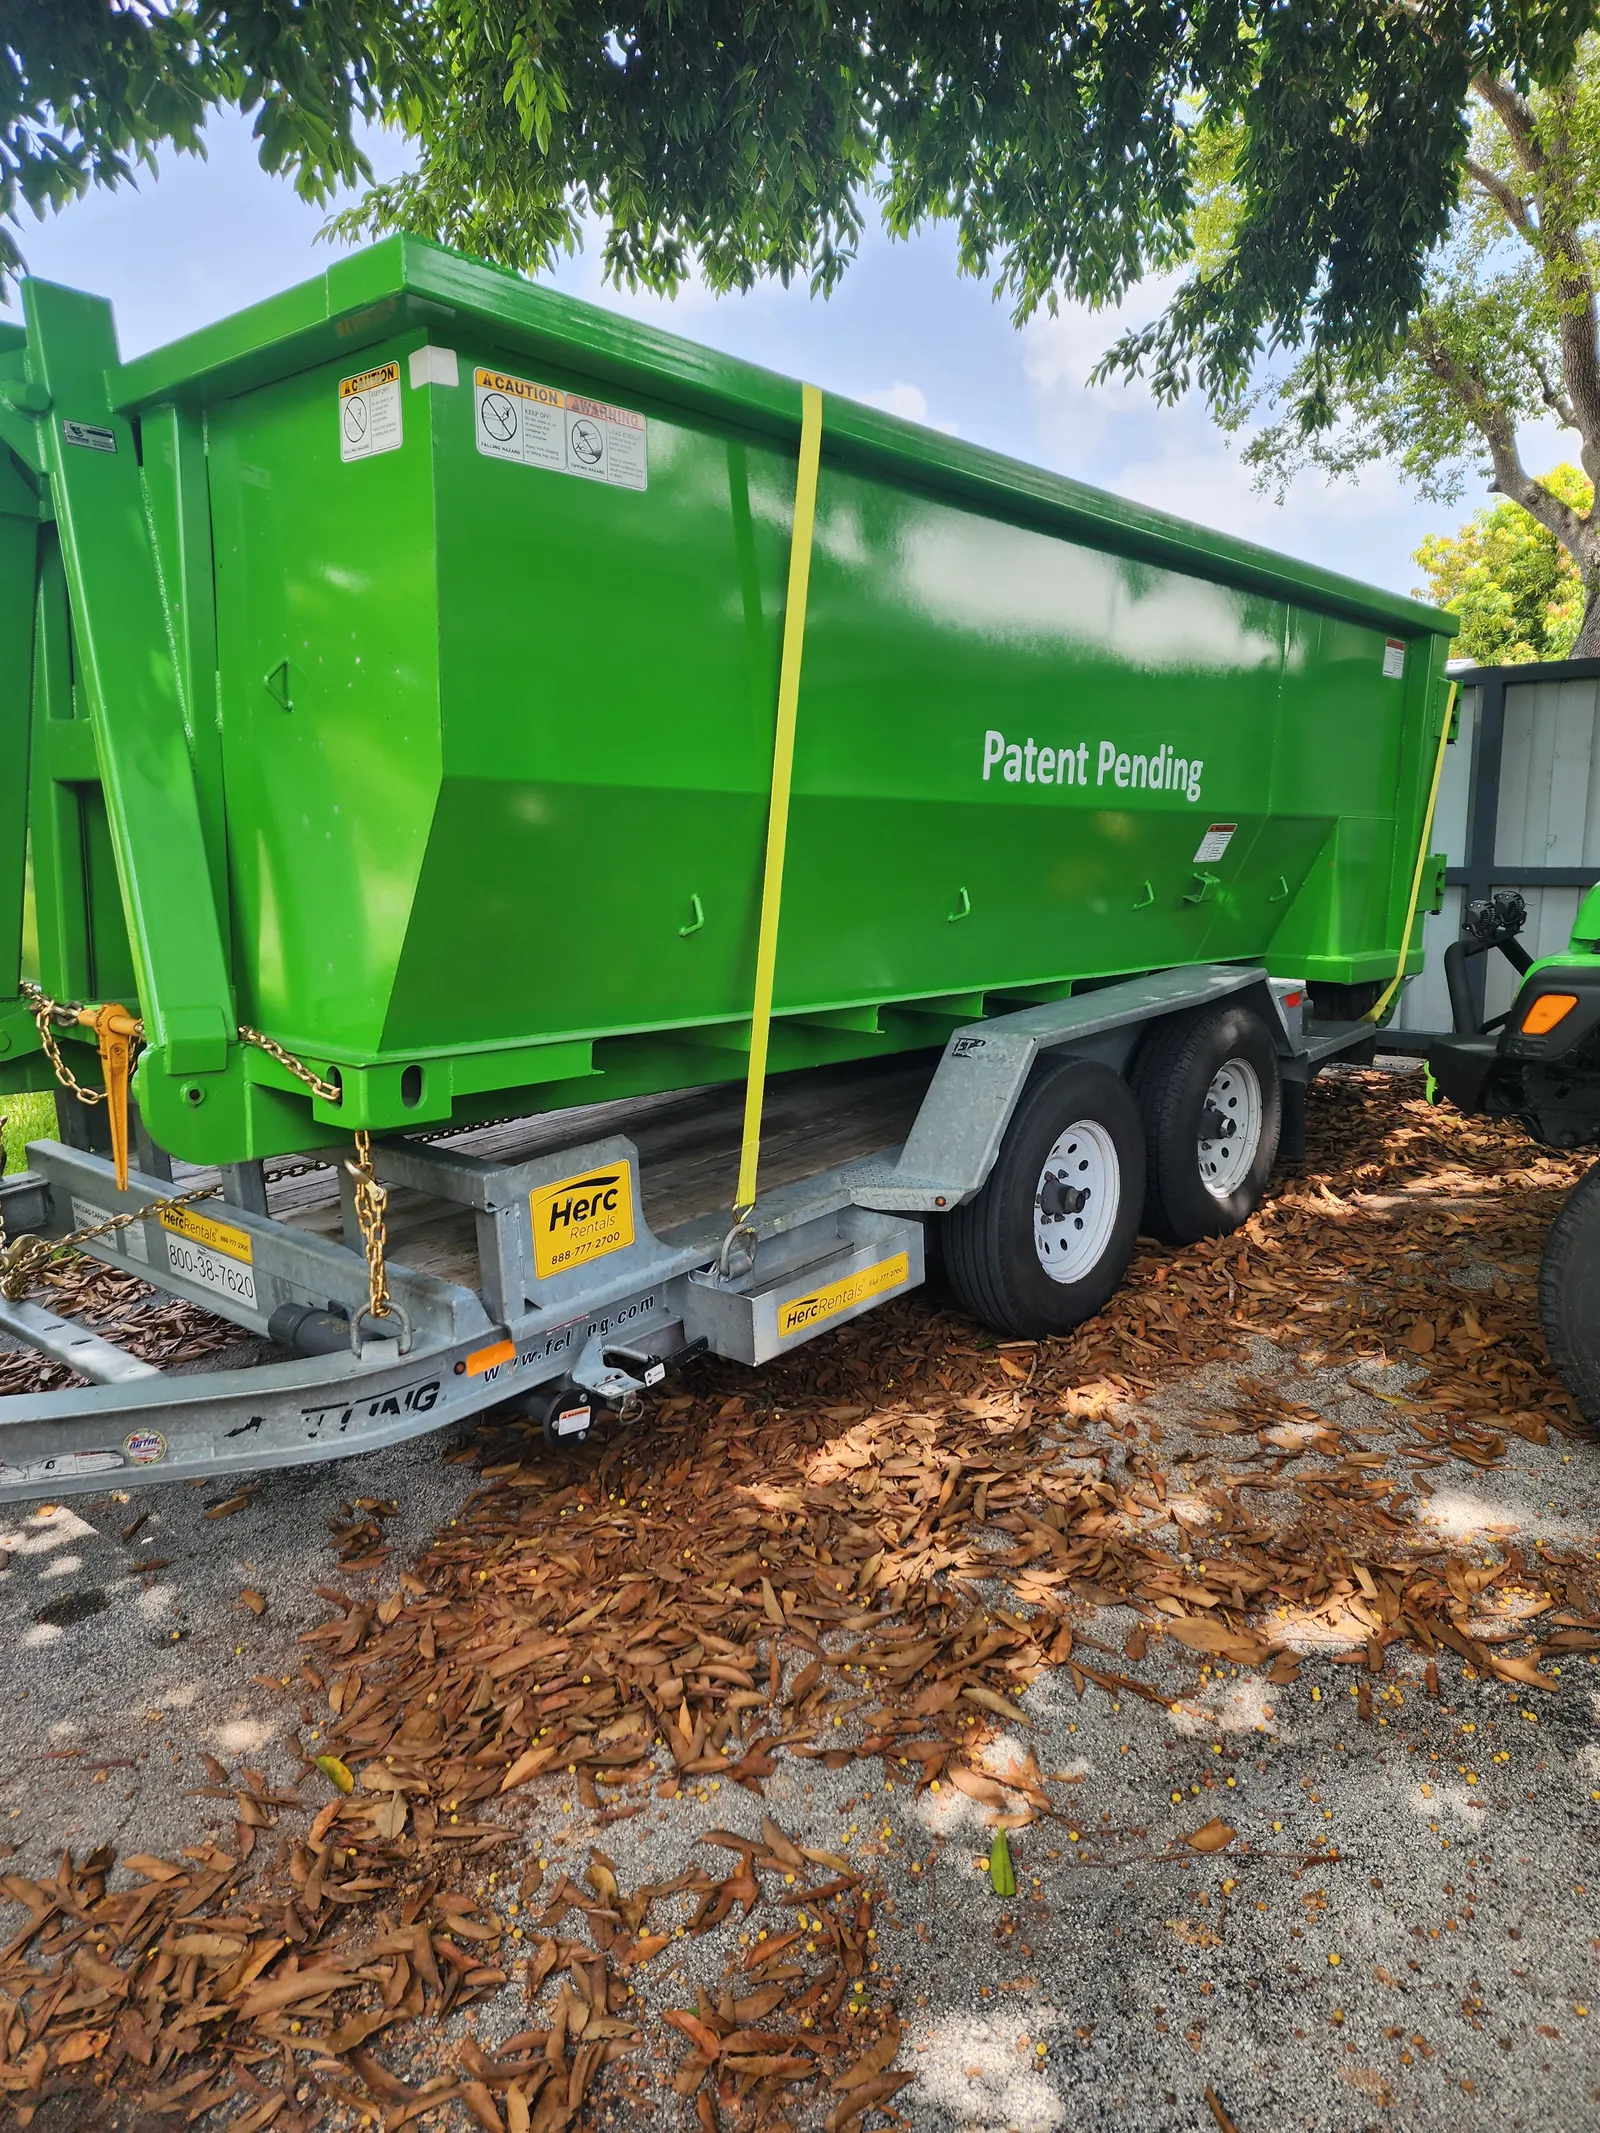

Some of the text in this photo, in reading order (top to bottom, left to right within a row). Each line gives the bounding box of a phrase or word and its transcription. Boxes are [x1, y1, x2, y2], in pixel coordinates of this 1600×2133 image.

[495, 375, 559, 405] CAUTION
[525, 409, 538, 417] KEEP
[581, 400, 639, 427] WARNING
[481, 441, 521, 455] FALLING HAZARD
[571, 462, 605, 475] TIPPING HAZARD
[982, 730, 1204, 802] Patent Pending
[164, 1209, 217, 1243] HercRentals
[549, 1188, 619, 1233] Herc
[570, 1214, 616, 1241] Rentals
[551, 1231, 621, 1265] 888-777-2700
[169, 1244, 254, 1299] 800-38-7620
[786, 1282, 864, 1329] HercRentals
